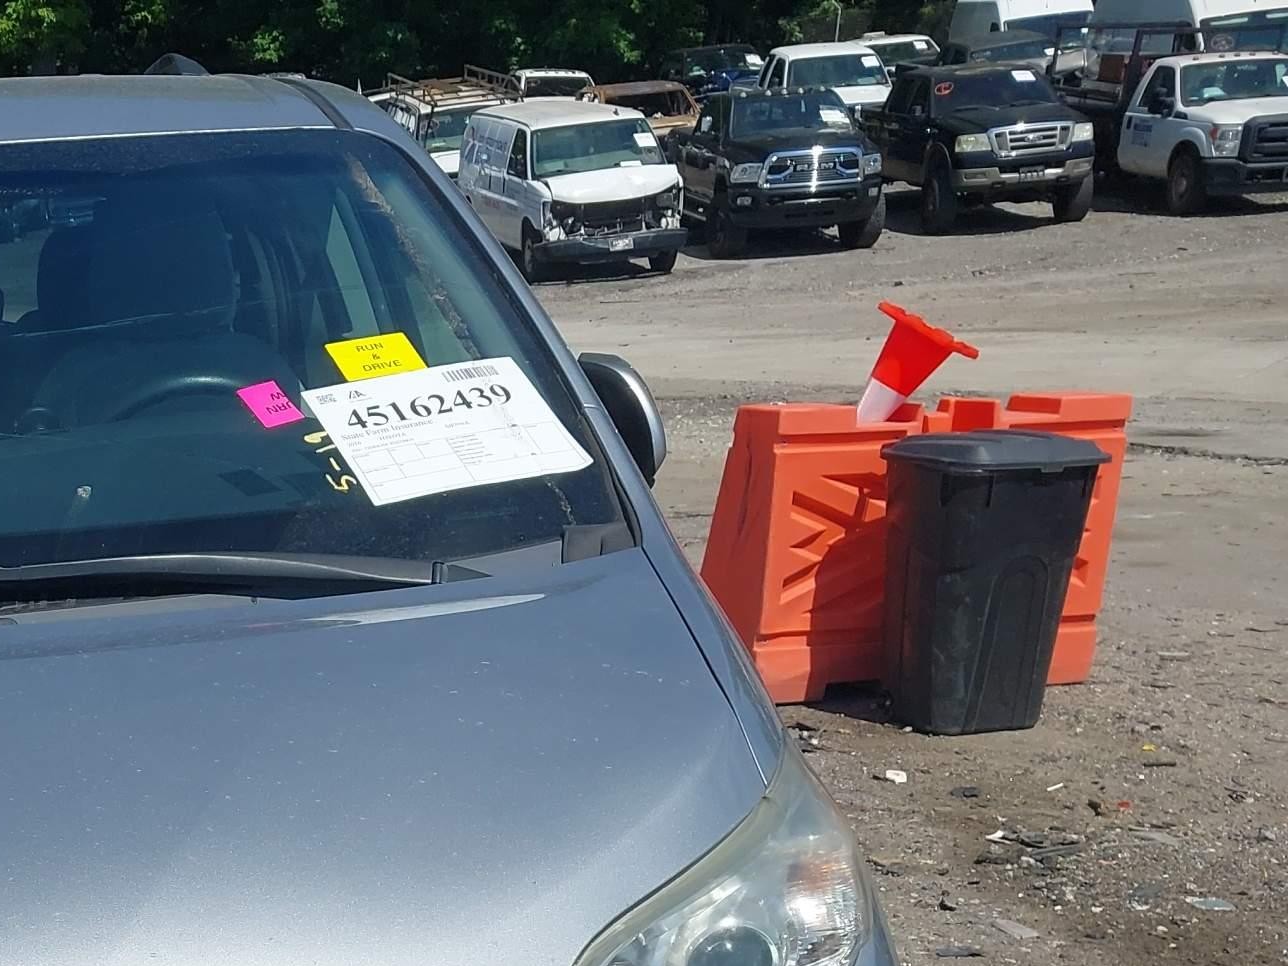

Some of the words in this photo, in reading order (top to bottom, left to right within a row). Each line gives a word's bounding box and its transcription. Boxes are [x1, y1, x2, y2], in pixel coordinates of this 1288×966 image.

[796, 163, 834, 172] RAM
[355, 342, 384, 352] RUN
[372, 352, 381, 360] &
[362, 359, 402, 372] DRIVE
[348, 383, 512, 429] 45162439
[341, 431, 364, 441] State
[365, 425, 389, 437] Farm
[389, 418, 434, 432] Insurance
